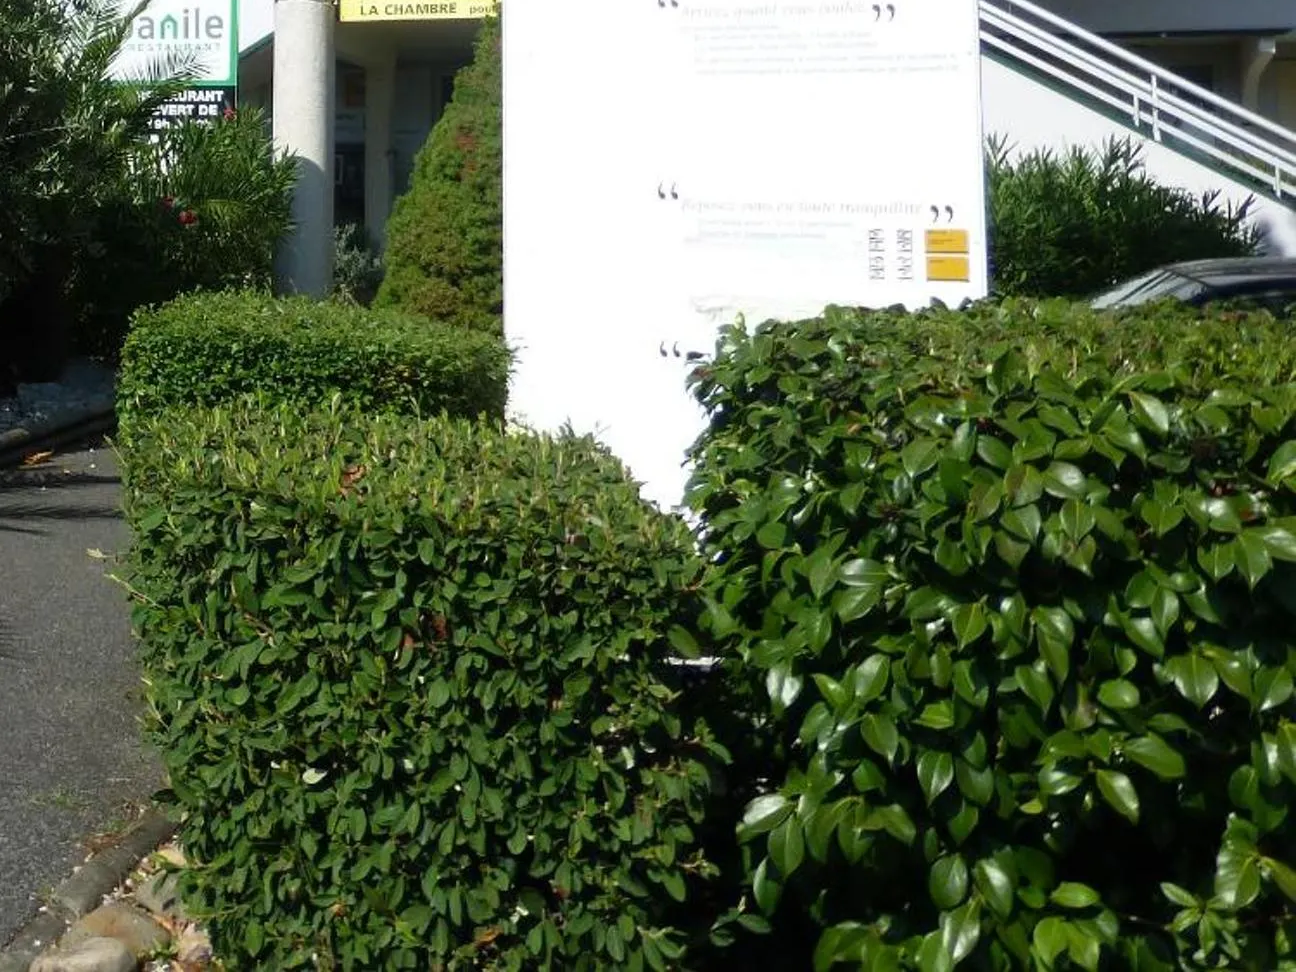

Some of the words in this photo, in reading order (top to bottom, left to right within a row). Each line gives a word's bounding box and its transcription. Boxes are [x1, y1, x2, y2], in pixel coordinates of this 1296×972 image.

[360, 3, 379, 16] LA
[384, 2, 457, 16] CHAMBRE
[198, 104, 219, 116] DE
